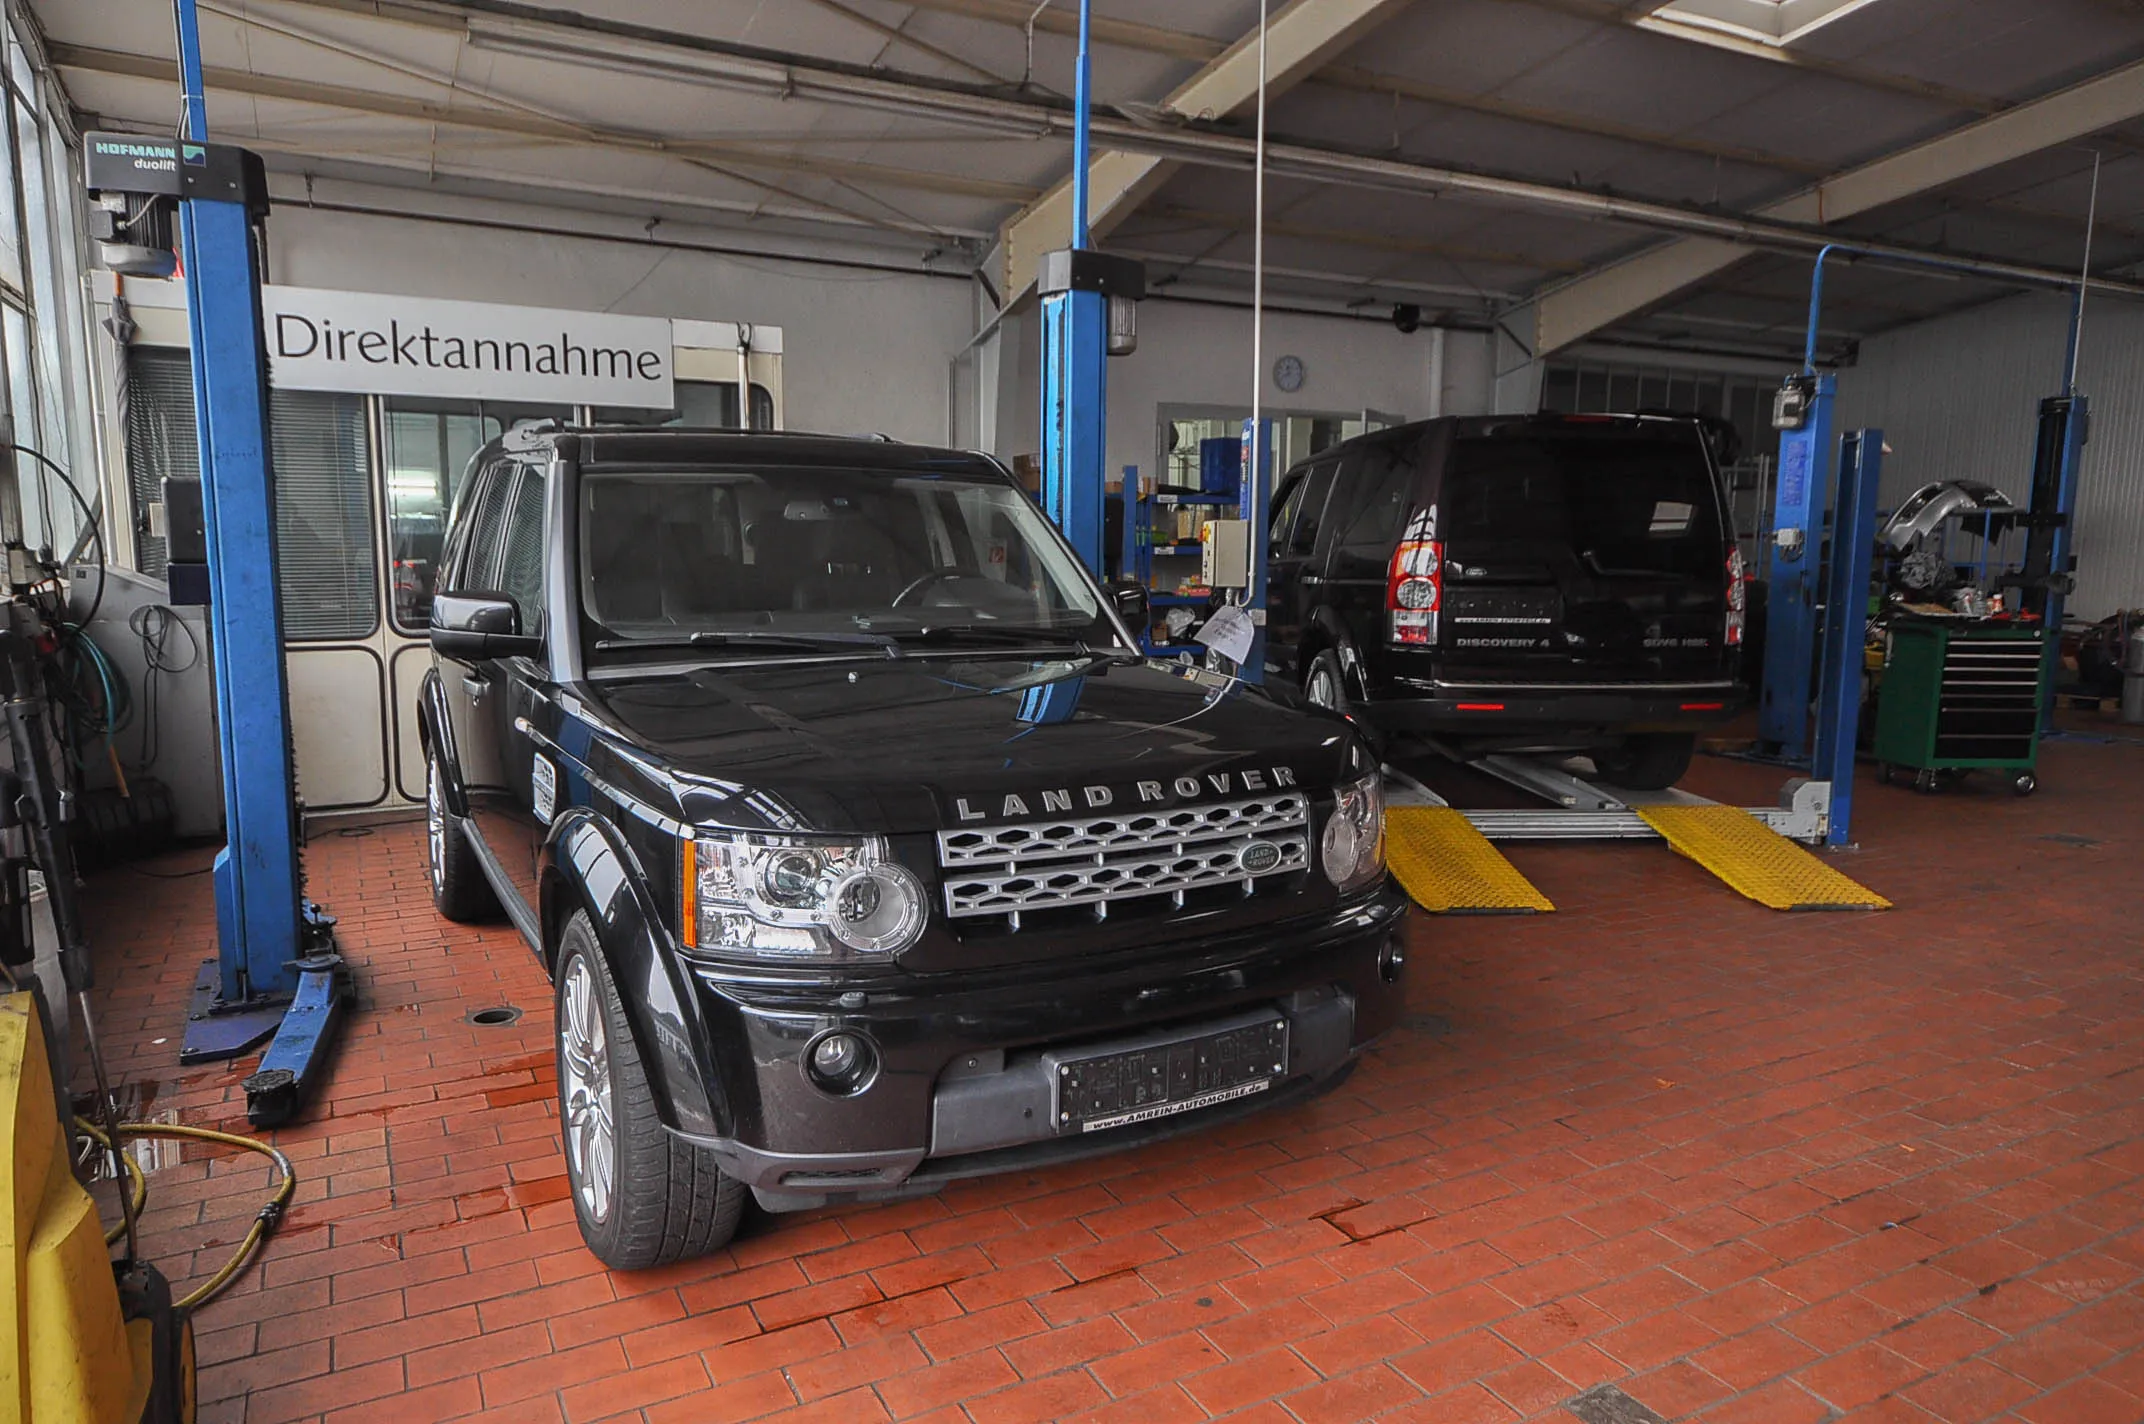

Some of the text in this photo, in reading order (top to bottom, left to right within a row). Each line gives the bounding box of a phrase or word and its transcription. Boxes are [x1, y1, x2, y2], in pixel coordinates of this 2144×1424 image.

[96, 142, 176, 159] HOFMANN
[134, 158, 176, 172] duolift
[275, 313, 662, 381] Direktannahme
[1456, 638, 1550, 648] DISCOVERY 4
[957, 766, 1297, 821] LAND ROVER
